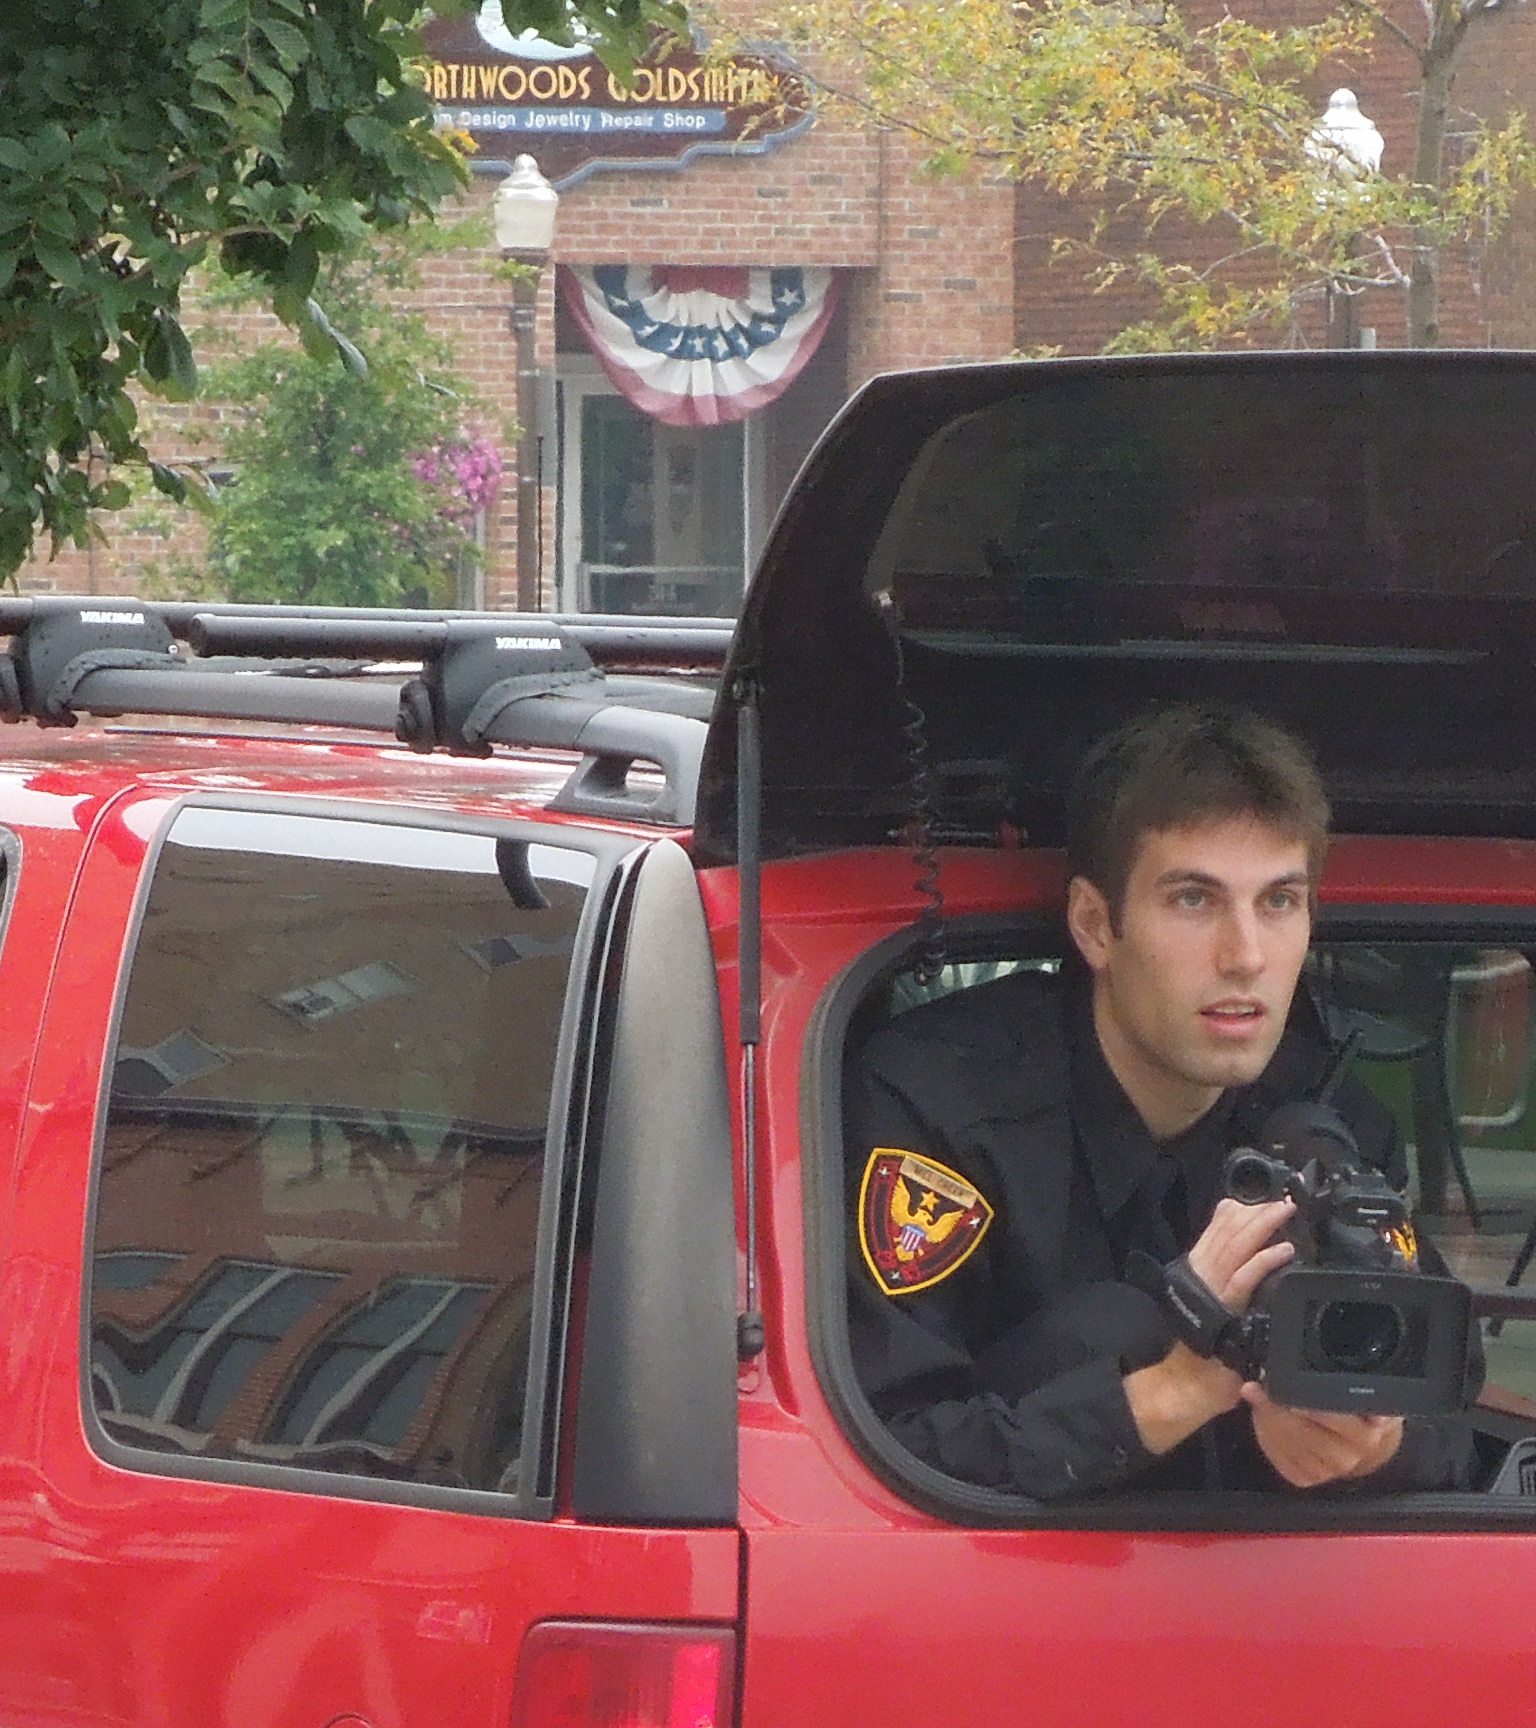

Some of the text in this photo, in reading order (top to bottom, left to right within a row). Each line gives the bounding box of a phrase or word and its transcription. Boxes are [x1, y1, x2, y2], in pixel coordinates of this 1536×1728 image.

[524, 110, 592, 131] Jewelry
[664, 112, 707, 129] Shop
[79, 610, 146, 625] YAKIMA
[494, 636, 562, 651] YAKIMA
